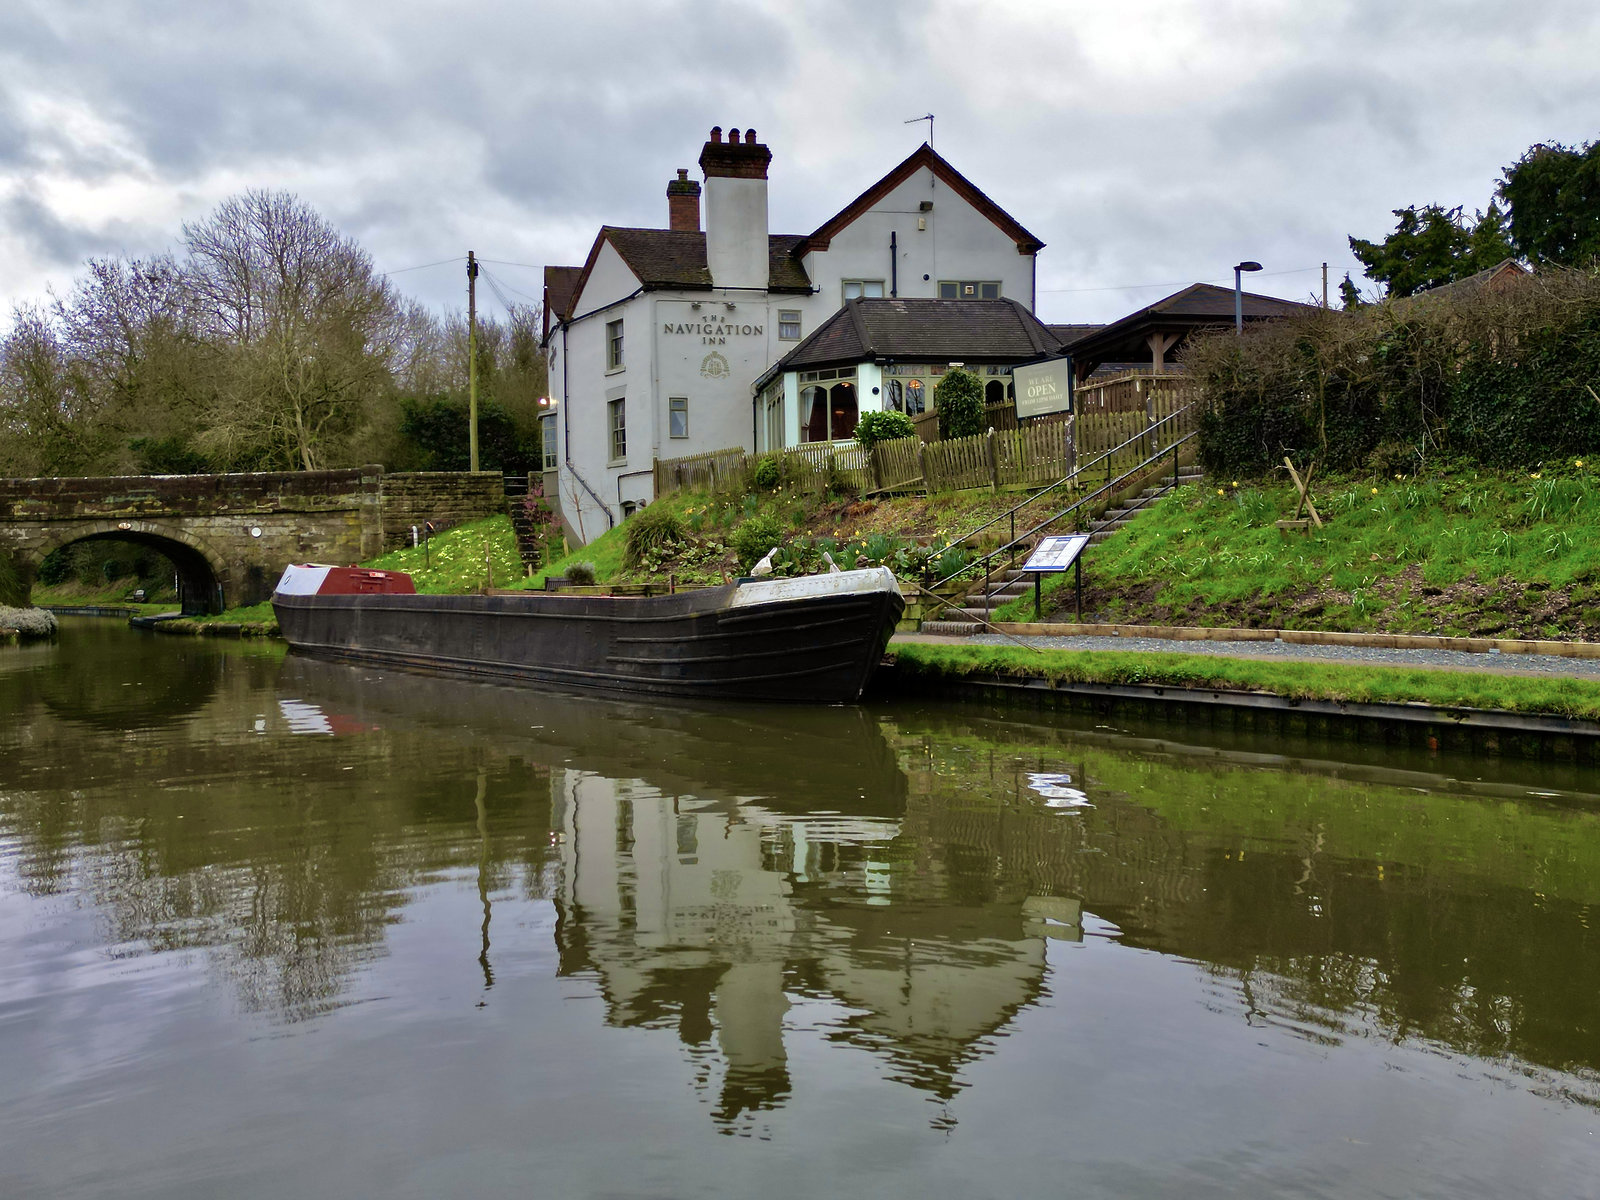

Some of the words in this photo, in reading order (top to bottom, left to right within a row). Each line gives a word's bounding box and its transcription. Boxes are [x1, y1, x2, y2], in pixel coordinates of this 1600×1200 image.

[702, 315, 725, 323] THE
[664, 323, 763, 335] NAVIGATION
[702, 337, 726, 345] INN
[1041, 375, 1053, 383] ARE
[1027, 382, 1056, 397] OPEN
